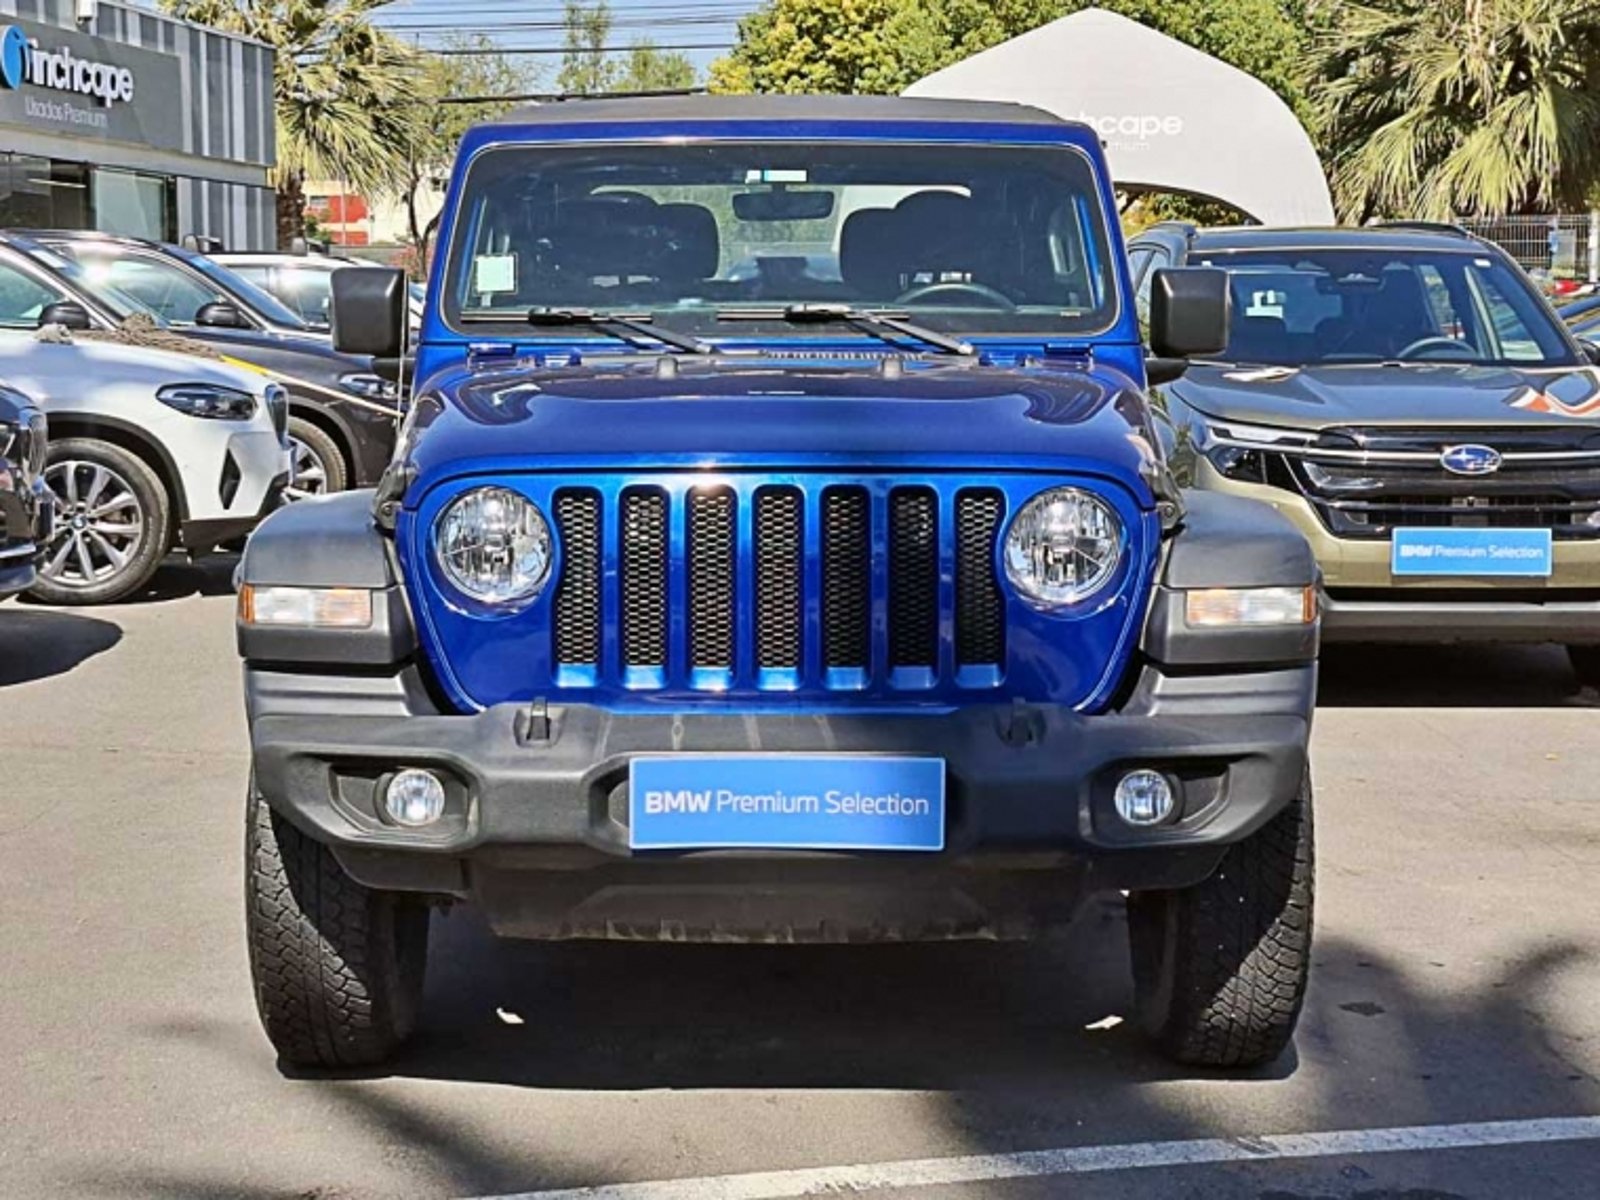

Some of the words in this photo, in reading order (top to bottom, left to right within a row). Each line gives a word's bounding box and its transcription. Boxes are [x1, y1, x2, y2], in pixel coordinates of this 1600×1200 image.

[30, 37, 134, 108] inchcape
[25, 96, 63, 121] Usados
[63, 102, 108, 129] Premium
[1400, 544, 1433, 558] BMW
[1435, 544, 1487, 558] Premium
[1488, 544, 1544, 559] Selection
[644, 790, 712, 814] BMW
[716, 789, 819, 814] Premium
[825, 790, 929, 815] Selection
